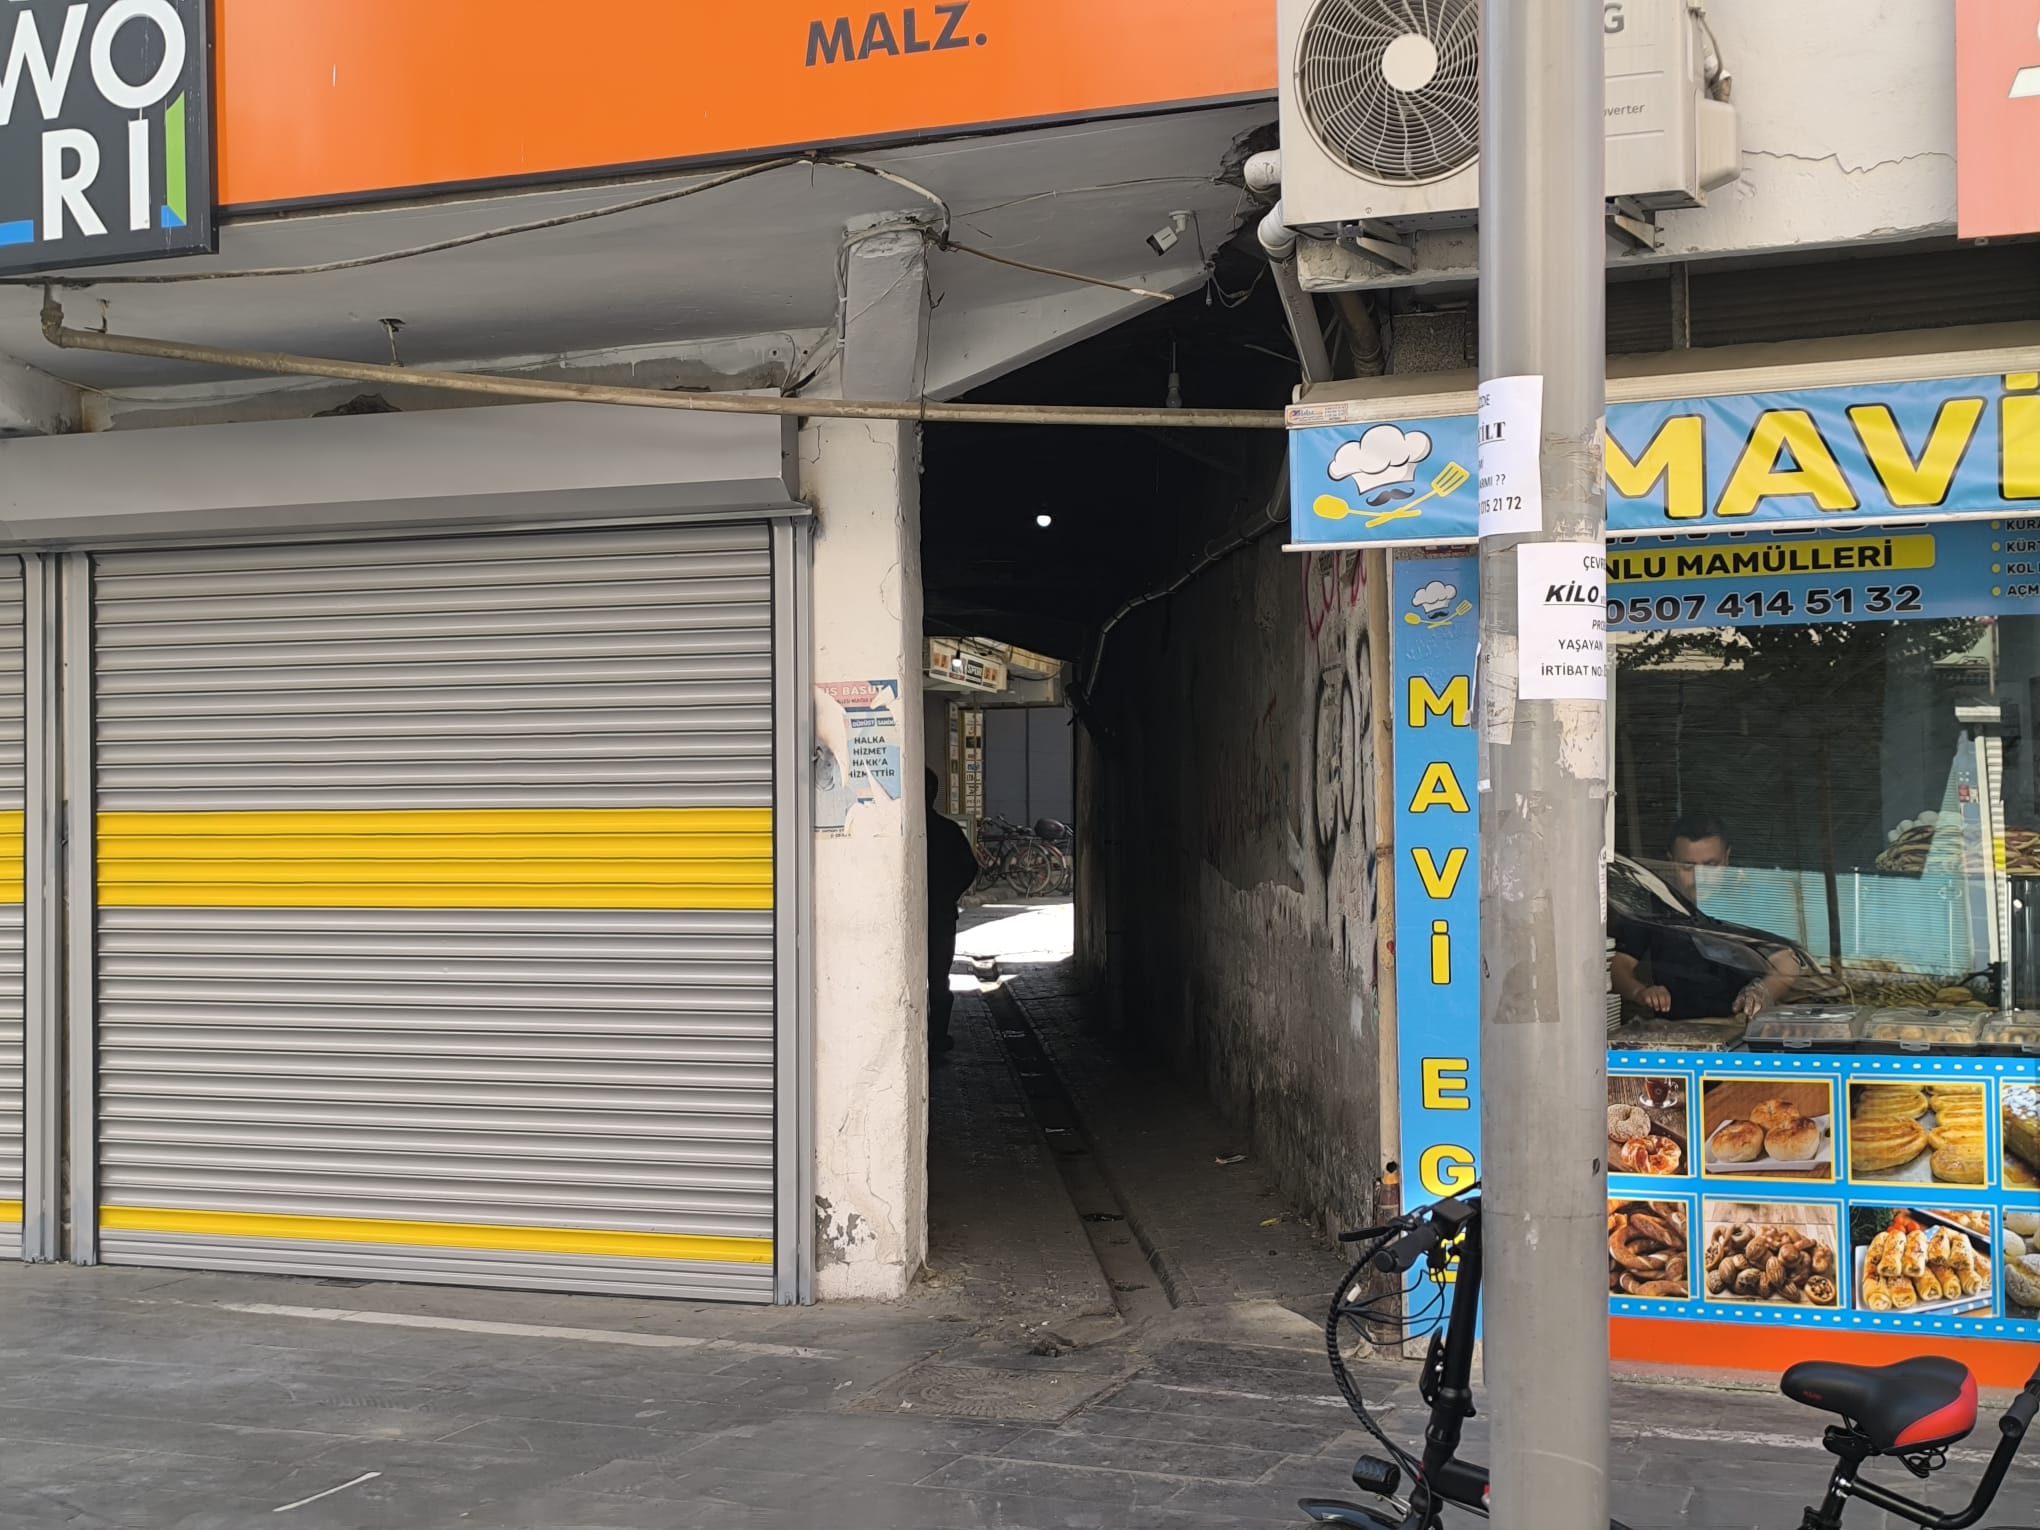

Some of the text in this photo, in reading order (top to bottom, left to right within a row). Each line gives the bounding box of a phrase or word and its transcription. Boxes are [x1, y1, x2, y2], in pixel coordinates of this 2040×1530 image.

[805, 1, 988, 67] MALZ.
[1492, 498, 1503, 512] 21
[1506, 496, 1522, 511] 72
[1677, 539, 1893, 577] MAMÜLLERİ
[1544, 580, 1599, 603] KİLO
[1716, 590, 1794, 620] 414
[1805, 587, 1854, 616] 51
[1864, 585, 1922, 613] 32
[1558, 639, 1603, 653] YAŞAYAN
[1541, 662, 1590, 676] İRTİBAT
[854, 736, 885, 744] HALKA
[853, 746, 887, 755] HİZMET
[1407, 675, 1470, 985] MAVİ
